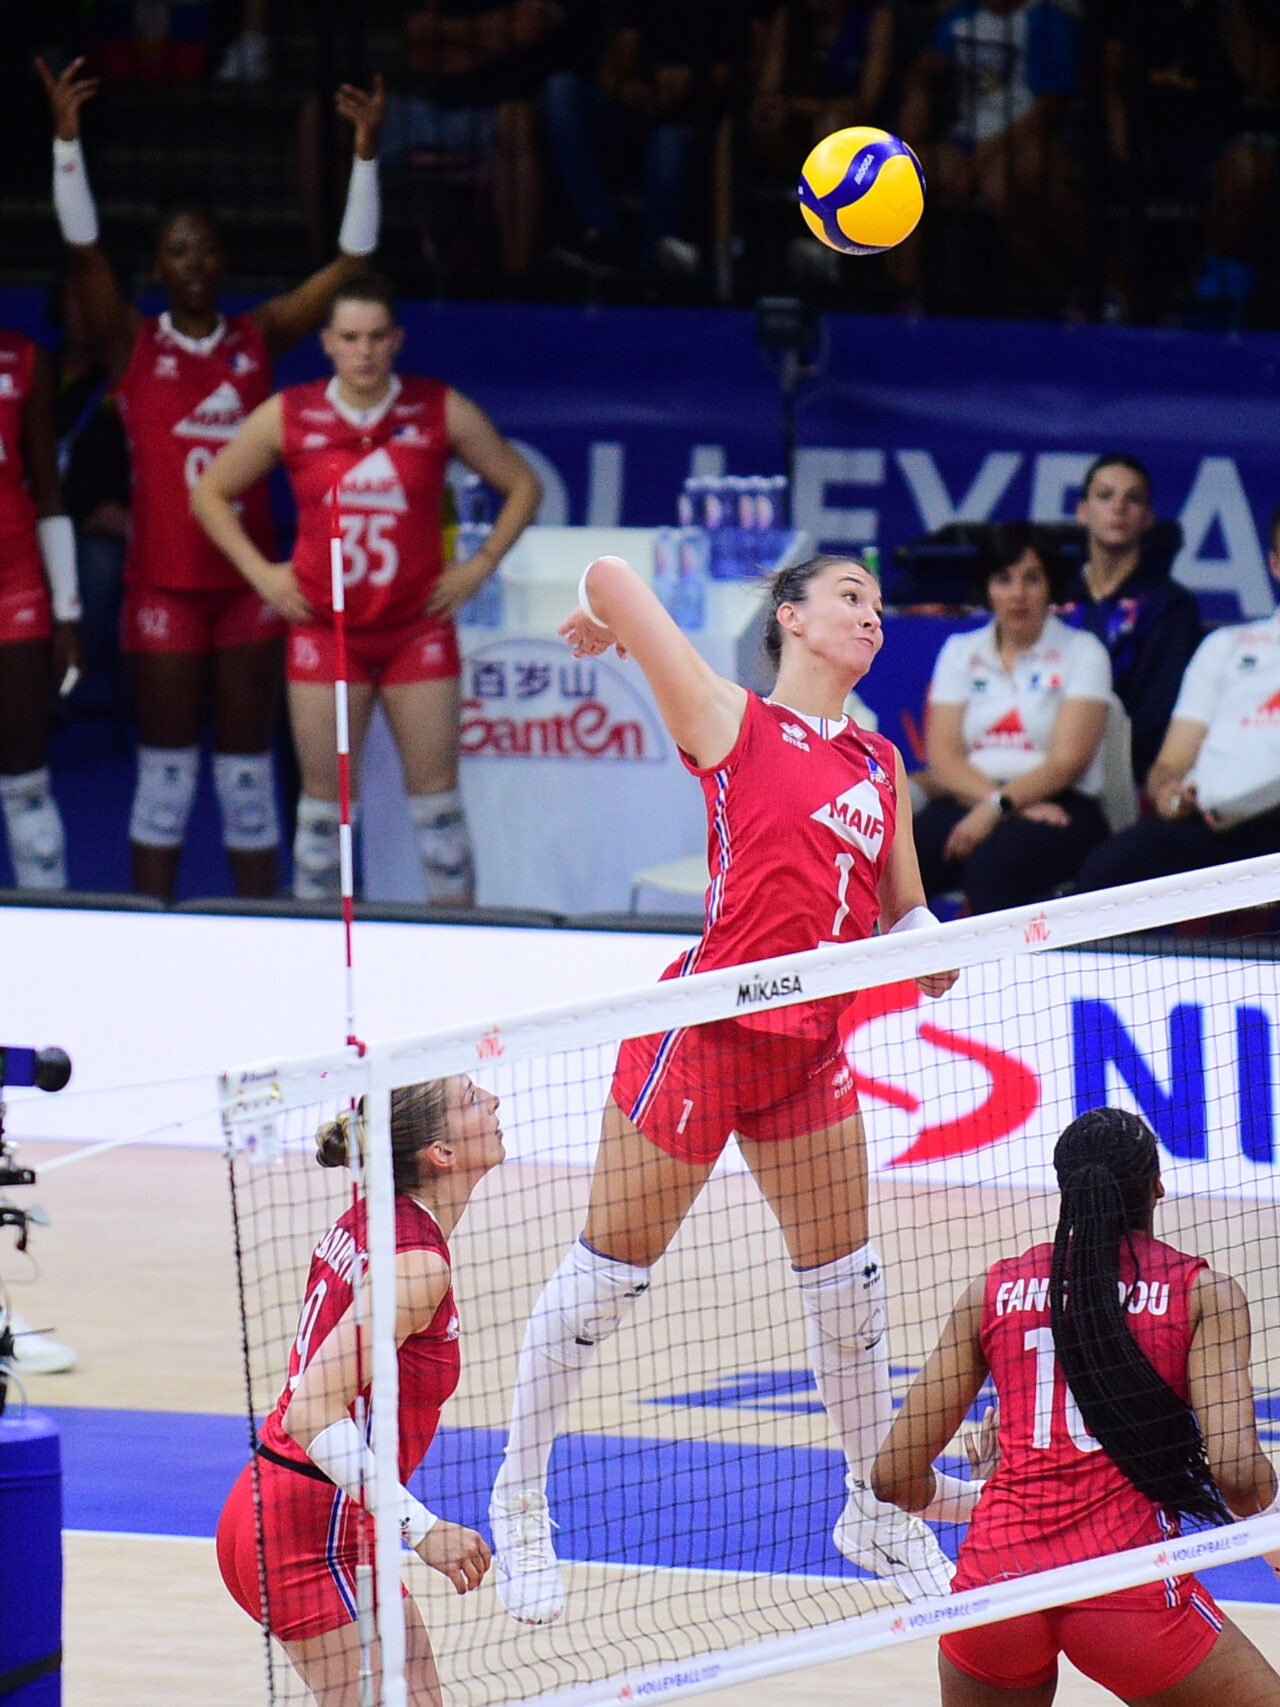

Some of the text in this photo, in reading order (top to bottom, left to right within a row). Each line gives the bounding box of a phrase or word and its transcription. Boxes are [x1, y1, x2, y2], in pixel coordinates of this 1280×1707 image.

[338, 513, 400, 588] 35
[470, 659, 597, 698] 百岁山
[828, 799, 885, 840] MAIF
[832, 852, 856, 937] 1
[736, 973, 803, 1007] MIKASA
[676, 1098, 694, 1135] 1
[1172, 1536, 1232, 1563] VOLLEYBALL
[908, 1602, 971, 1628] VOLLEYBALL
[636, 1668, 700, 1696] VOLLEYBALL
